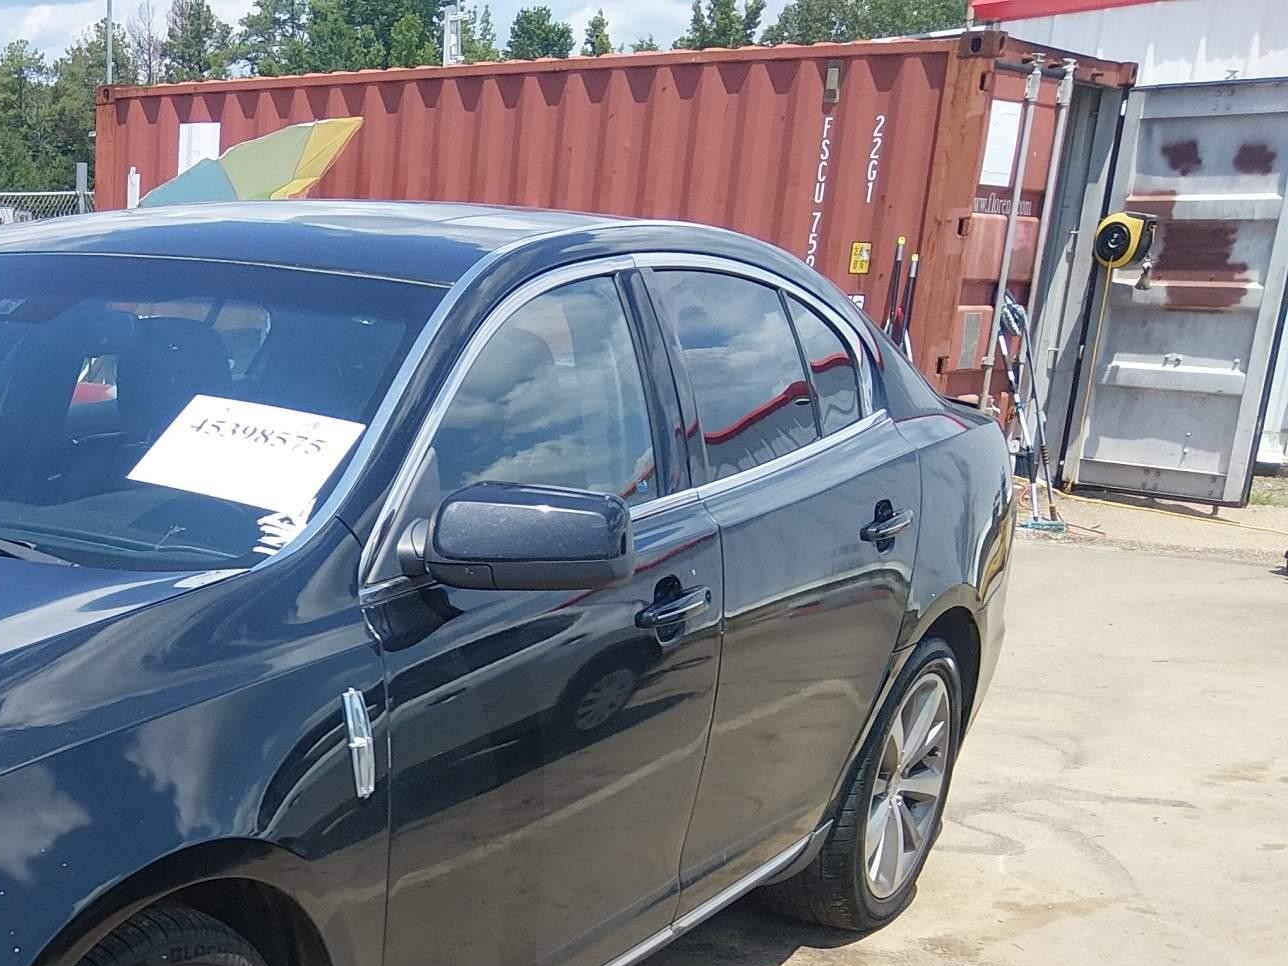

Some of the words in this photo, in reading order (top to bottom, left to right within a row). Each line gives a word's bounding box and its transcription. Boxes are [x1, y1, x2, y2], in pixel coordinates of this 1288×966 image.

[814, 116, 834, 204] FSCU
[866, 115, 886, 204] 22G1
[190, 418, 328, 454] 45398575
